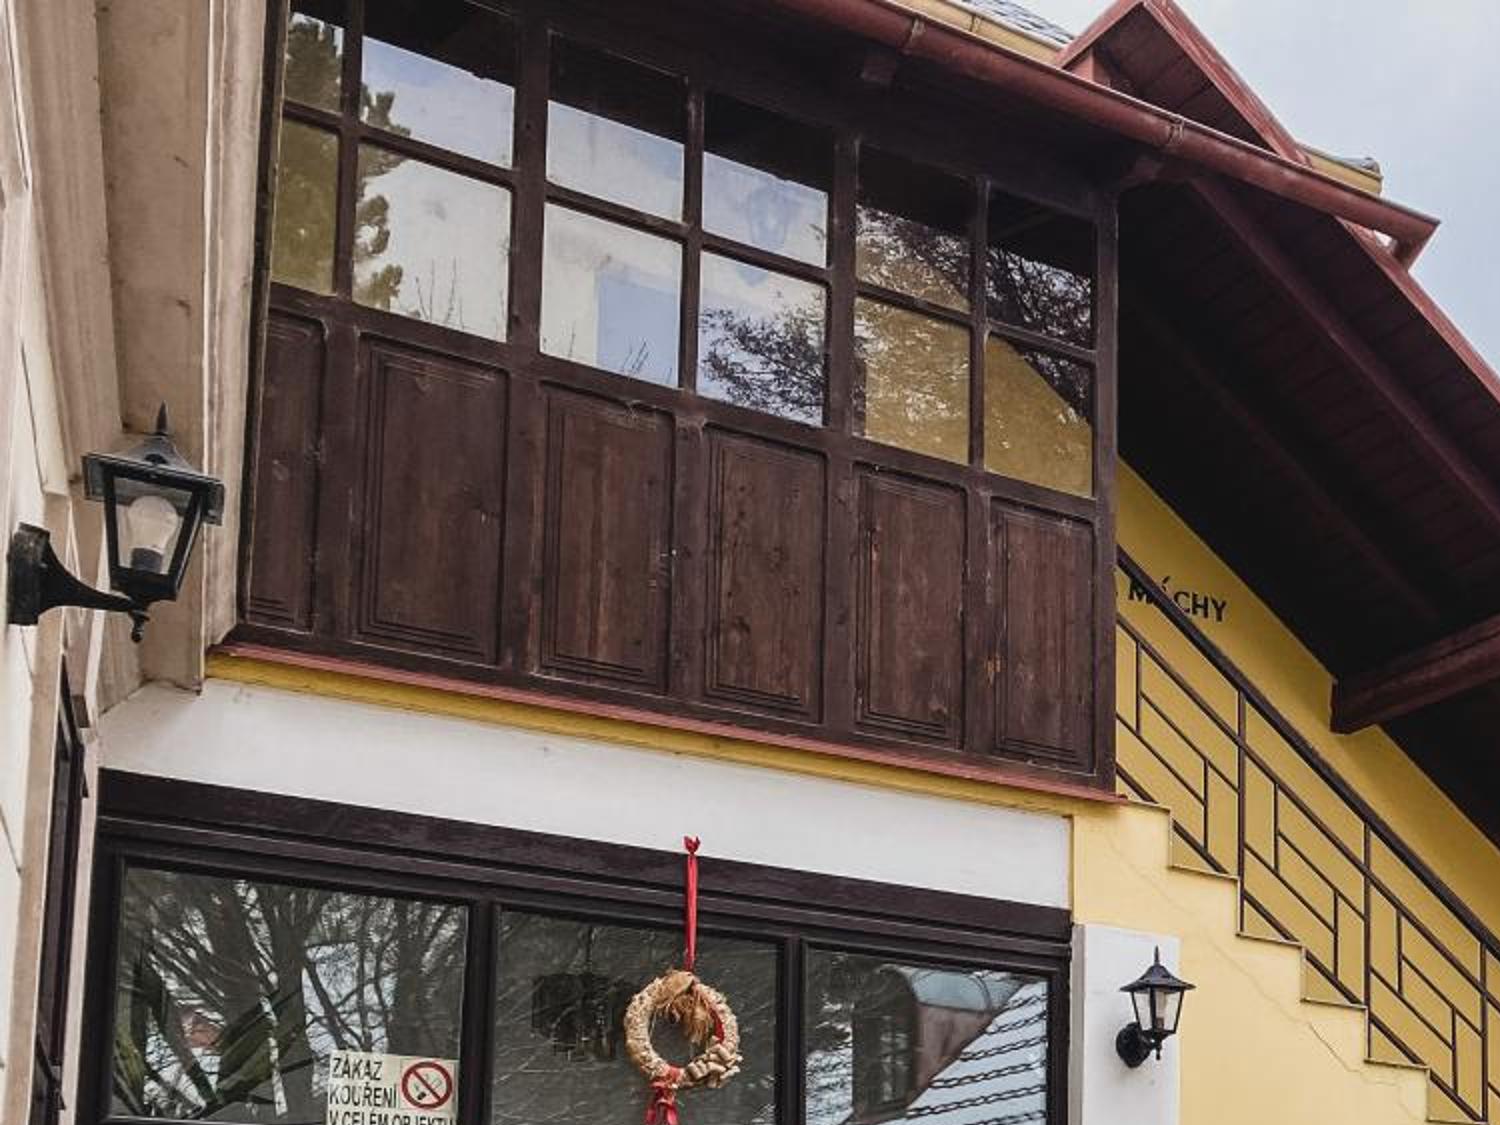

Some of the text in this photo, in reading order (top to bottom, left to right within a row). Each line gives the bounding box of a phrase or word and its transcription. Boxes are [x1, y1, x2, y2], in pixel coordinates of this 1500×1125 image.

[1128, 576, 1227, 622] MCHY
[332, 1053, 383, 1081] ZÁKAZ
[328, 1081, 397, 1108] KOUŘENÍ
